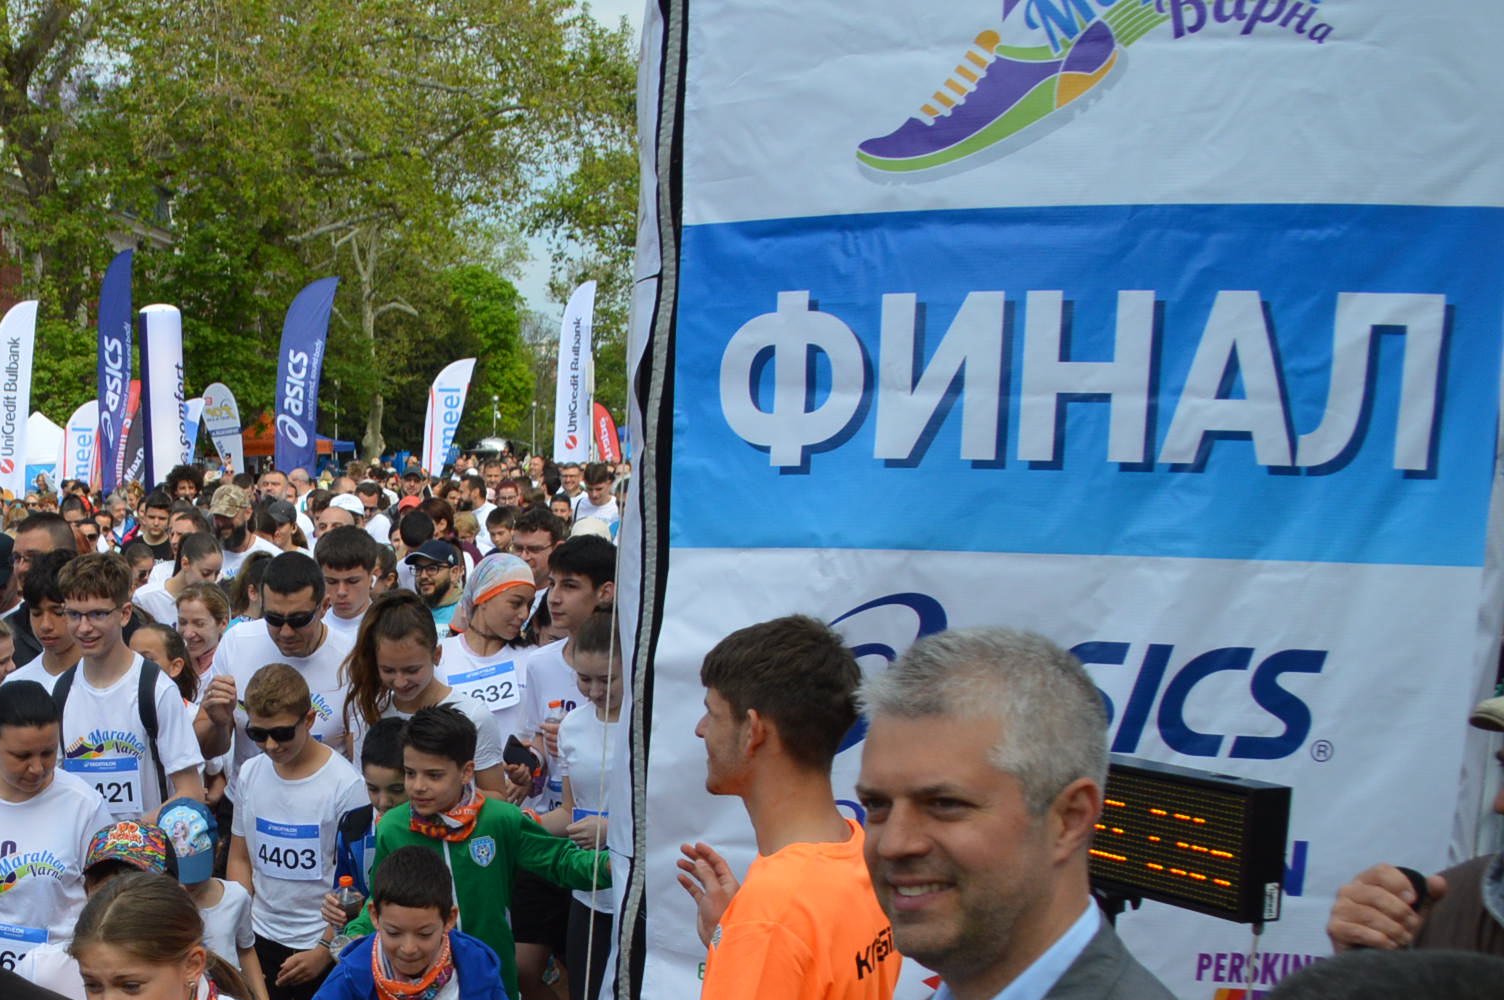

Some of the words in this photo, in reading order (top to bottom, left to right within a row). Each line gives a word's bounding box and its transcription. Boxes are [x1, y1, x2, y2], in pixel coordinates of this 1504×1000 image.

[4, 336, 21, 392] Bulbank
[718, 289, 1448, 472] ФИНАЛ
[1, 393, 17, 456] UniCredit
[462, 681, 515, 704] 632
[26, 864, 64, 881] Varna
[258, 843, 317, 870] 4403
